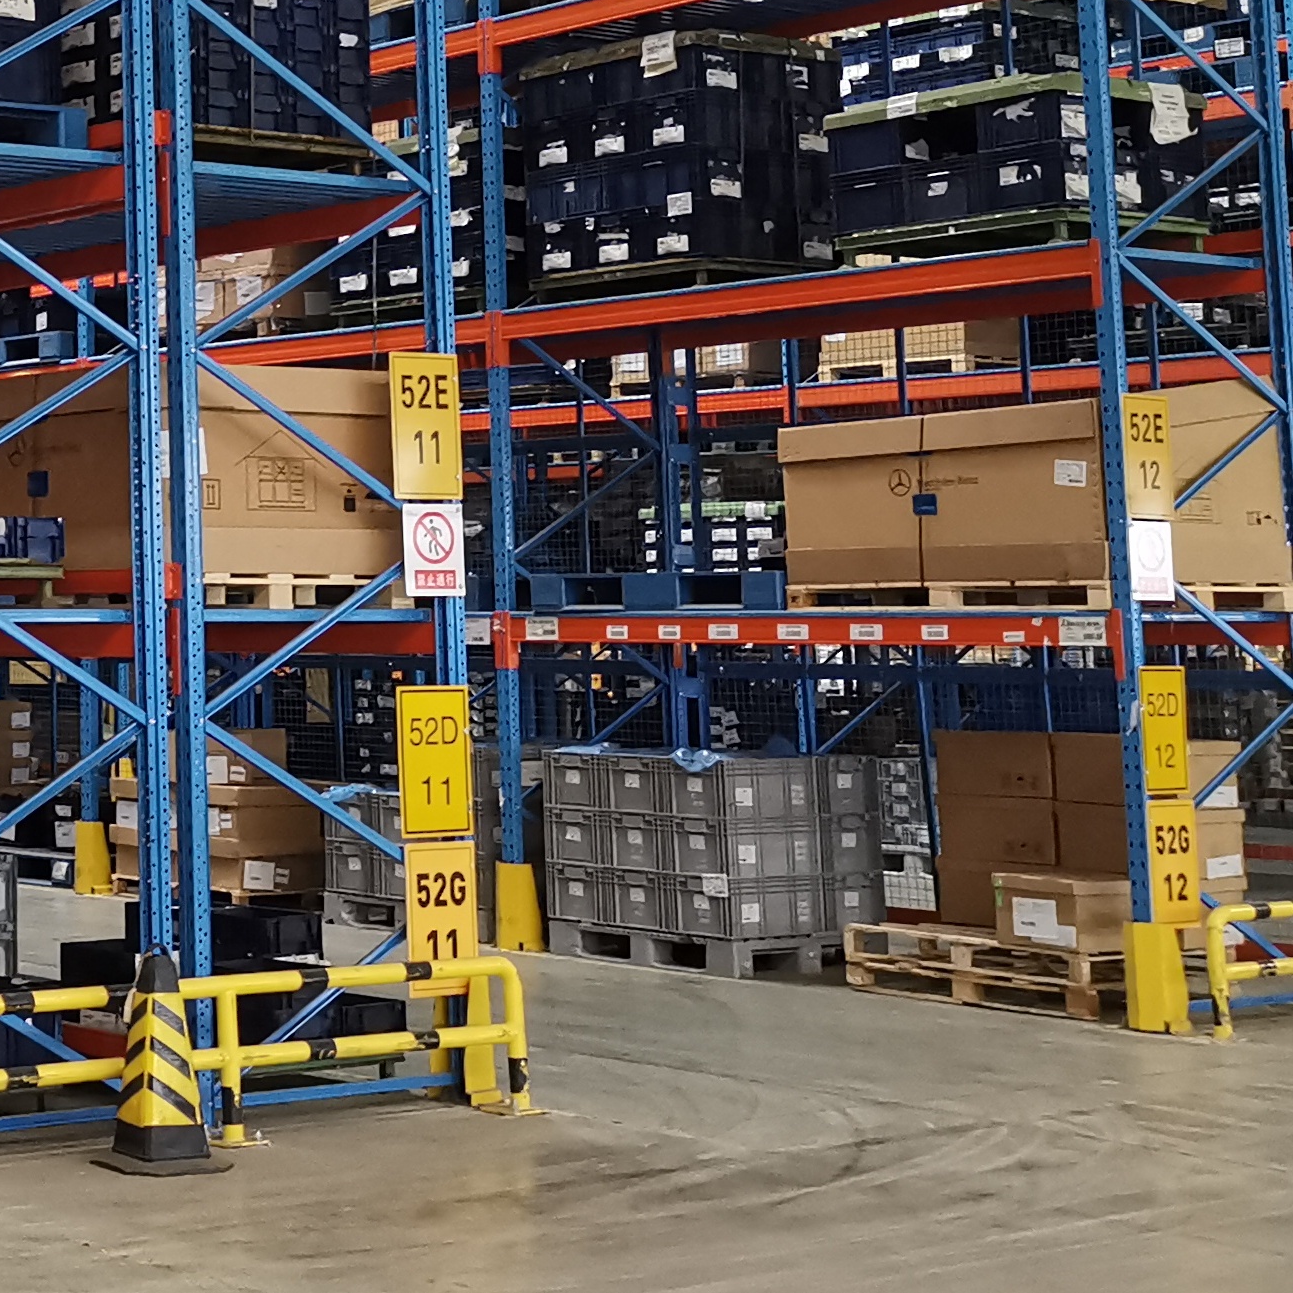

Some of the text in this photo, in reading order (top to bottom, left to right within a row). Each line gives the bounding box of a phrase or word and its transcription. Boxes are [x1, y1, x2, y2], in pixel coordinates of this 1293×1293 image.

[401, 374, 449, 409] 52E
[1130, 413, 1164, 444] 52E
[414, 430, 440, 464] 11
[1139, 460, 1161, 490] 12
[1146, 693, 1178, 717] 52D
[409, 716, 458, 746] 52D
[1155, 744, 1175, 768] 12
[421, 776, 451, 805] 11
[1155, 825, 1190, 855] 52G
[416, 871, 466, 908] 52G
[1164, 873, 1189, 901] 12
[426, 929, 459, 961] 11
